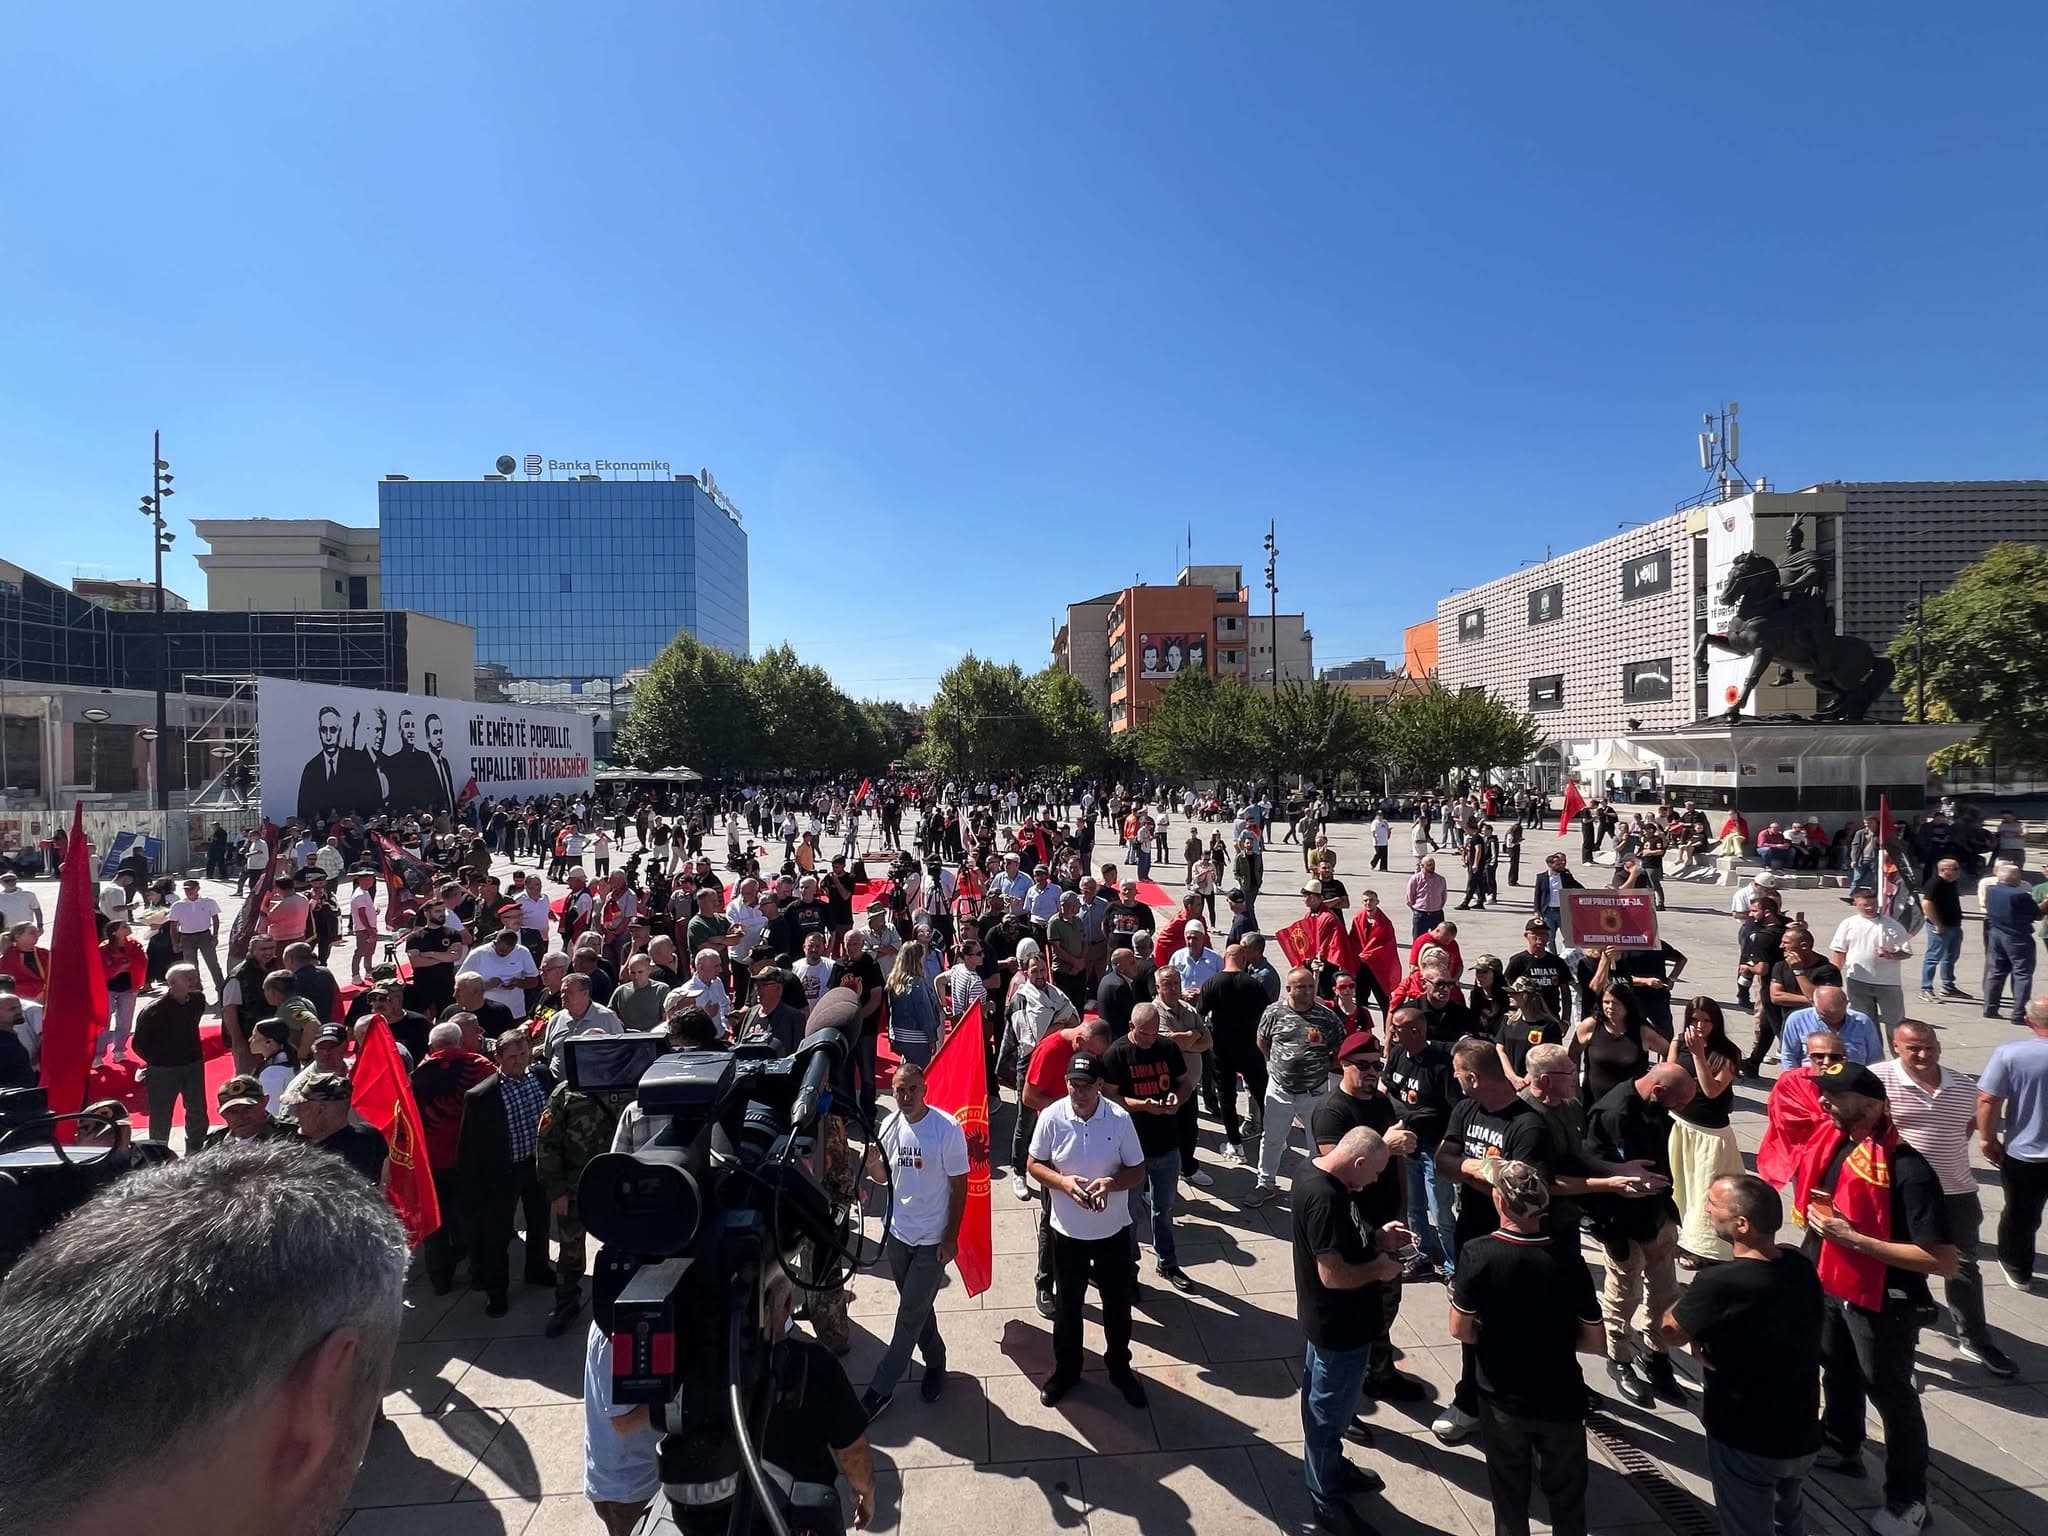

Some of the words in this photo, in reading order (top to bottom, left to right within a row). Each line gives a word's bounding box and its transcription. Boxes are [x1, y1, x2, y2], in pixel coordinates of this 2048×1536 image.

[549, 459, 591, 470] Banka
[595, 459, 670, 470] Ekonomike
[469, 714, 484, 747] NË
[486, 716, 514, 748] EMËR
[515, 718, 527, 748] TË
[530, 724, 572, 750] POPULLIT,
[471, 756, 527, 783] SHPALLENI
[528, 752, 539, 780] TË
[540, 752, 589, 780] PAFAJSHËM!
[1407, 1077, 1419, 1091] KA
[1466, 1124, 1490, 1142] LIRIA
[1488, 1130, 1503, 1148] KA
[914, 1147, 922, 1157] KA
[970, 1183, 989, 1192] KOS
